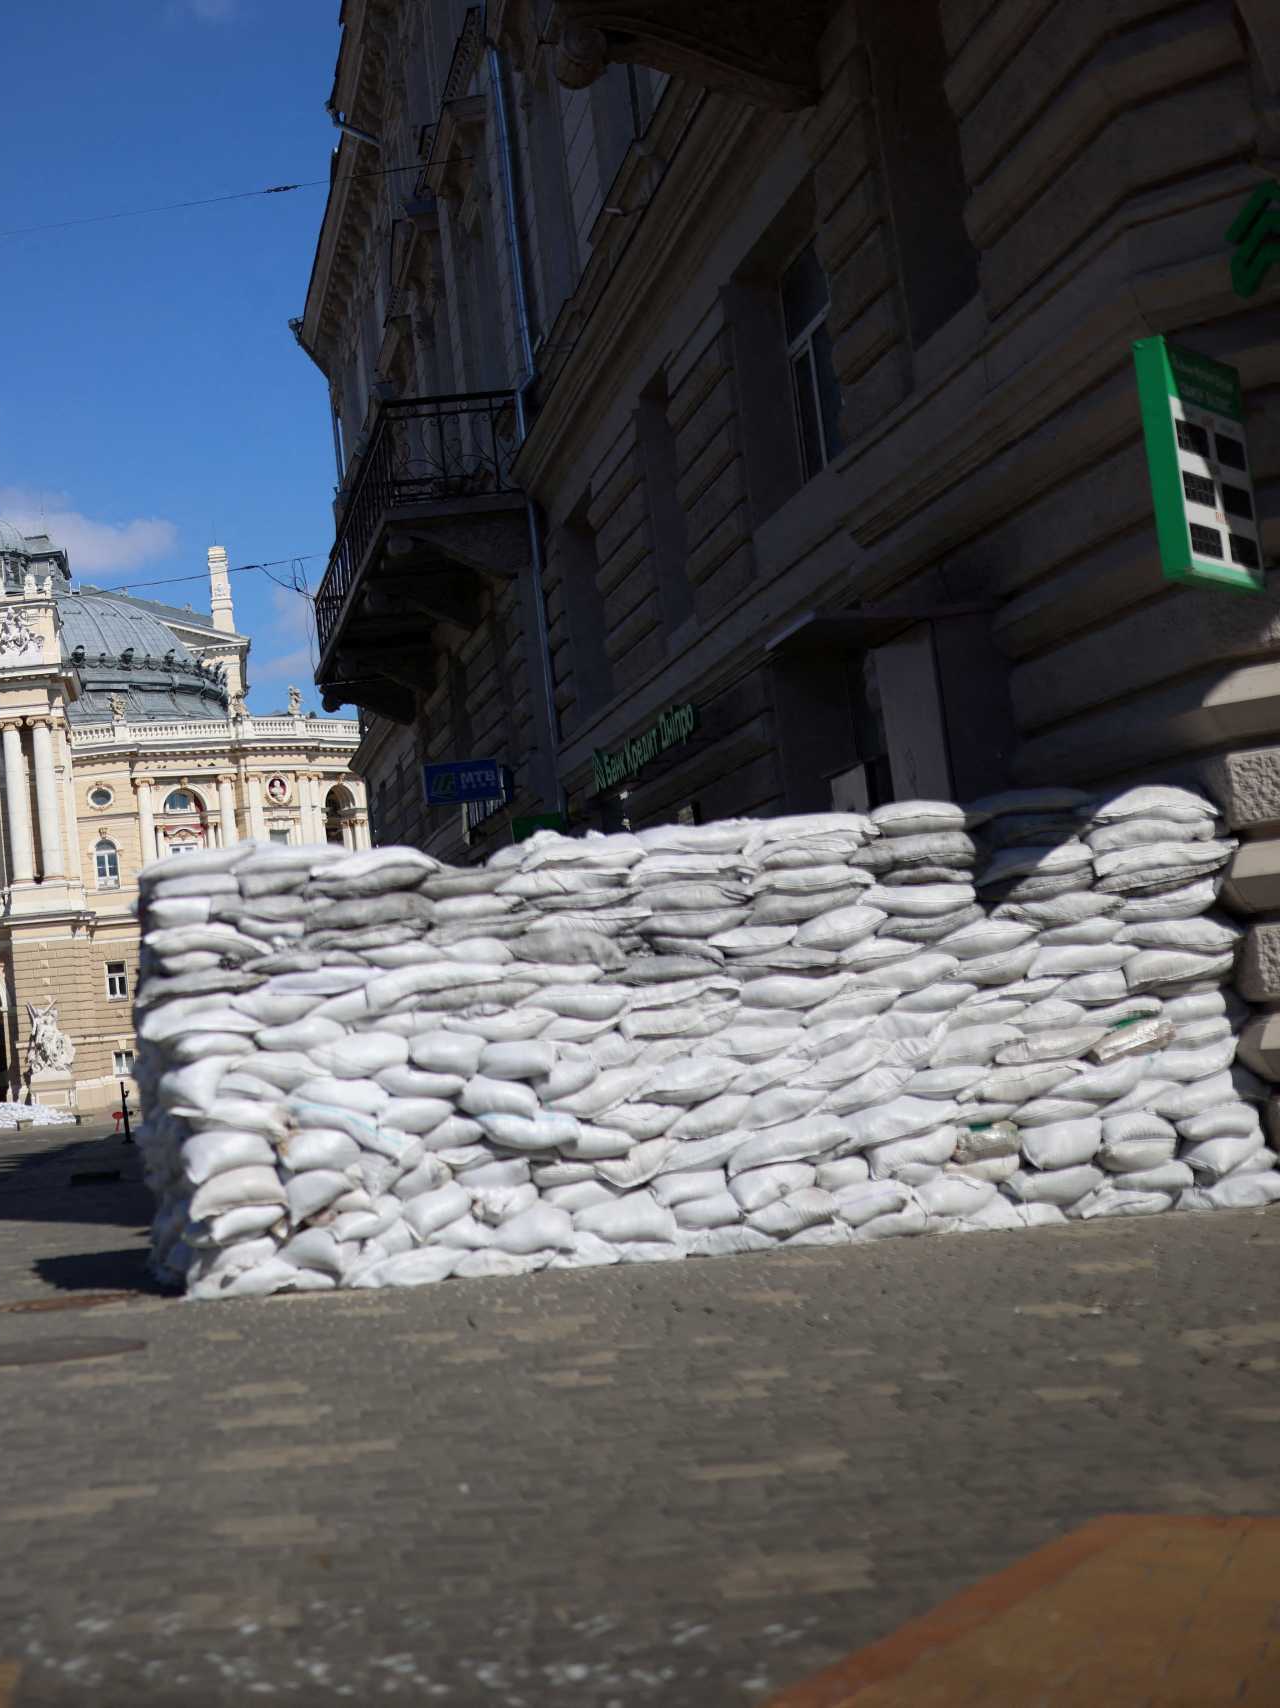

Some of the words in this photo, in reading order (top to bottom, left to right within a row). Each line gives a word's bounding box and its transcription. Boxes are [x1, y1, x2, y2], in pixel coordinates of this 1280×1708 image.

[605, 753, 627, 784] Банк
[624, 729, 658, 775] Кредит
[658, 703, 694, 750] Дніпро
